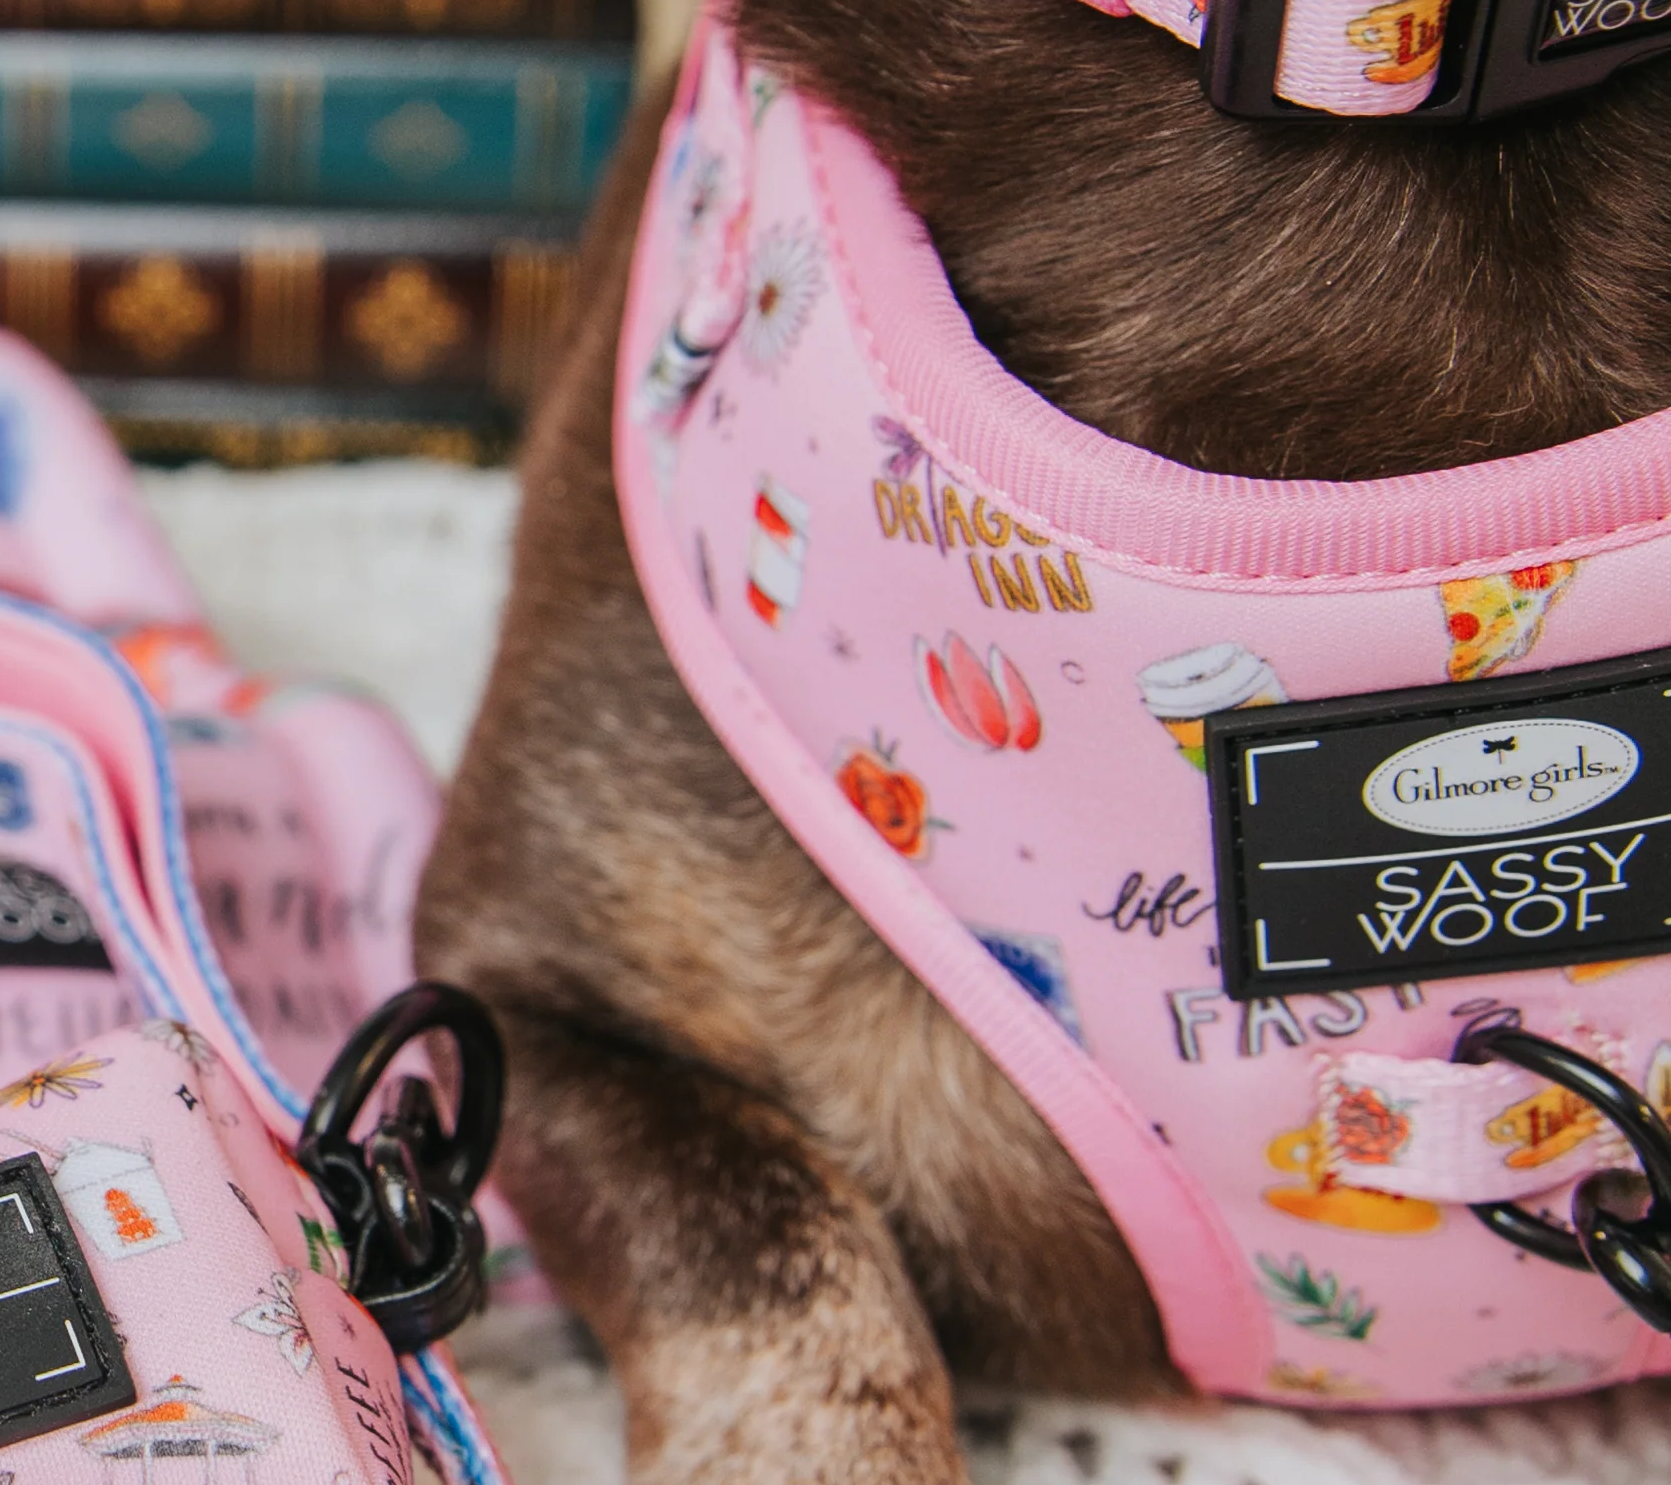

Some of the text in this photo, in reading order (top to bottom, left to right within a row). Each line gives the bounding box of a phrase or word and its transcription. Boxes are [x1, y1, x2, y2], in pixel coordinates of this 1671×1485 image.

[966, 550, 1094, 614] INN
[1392, 766, 1522, 804] Gilmore
[1082, 871, 1218, 937] life
[1375, 833, 1646, 913] SASSY
[1357, 881, 1628, 954] WOOF
